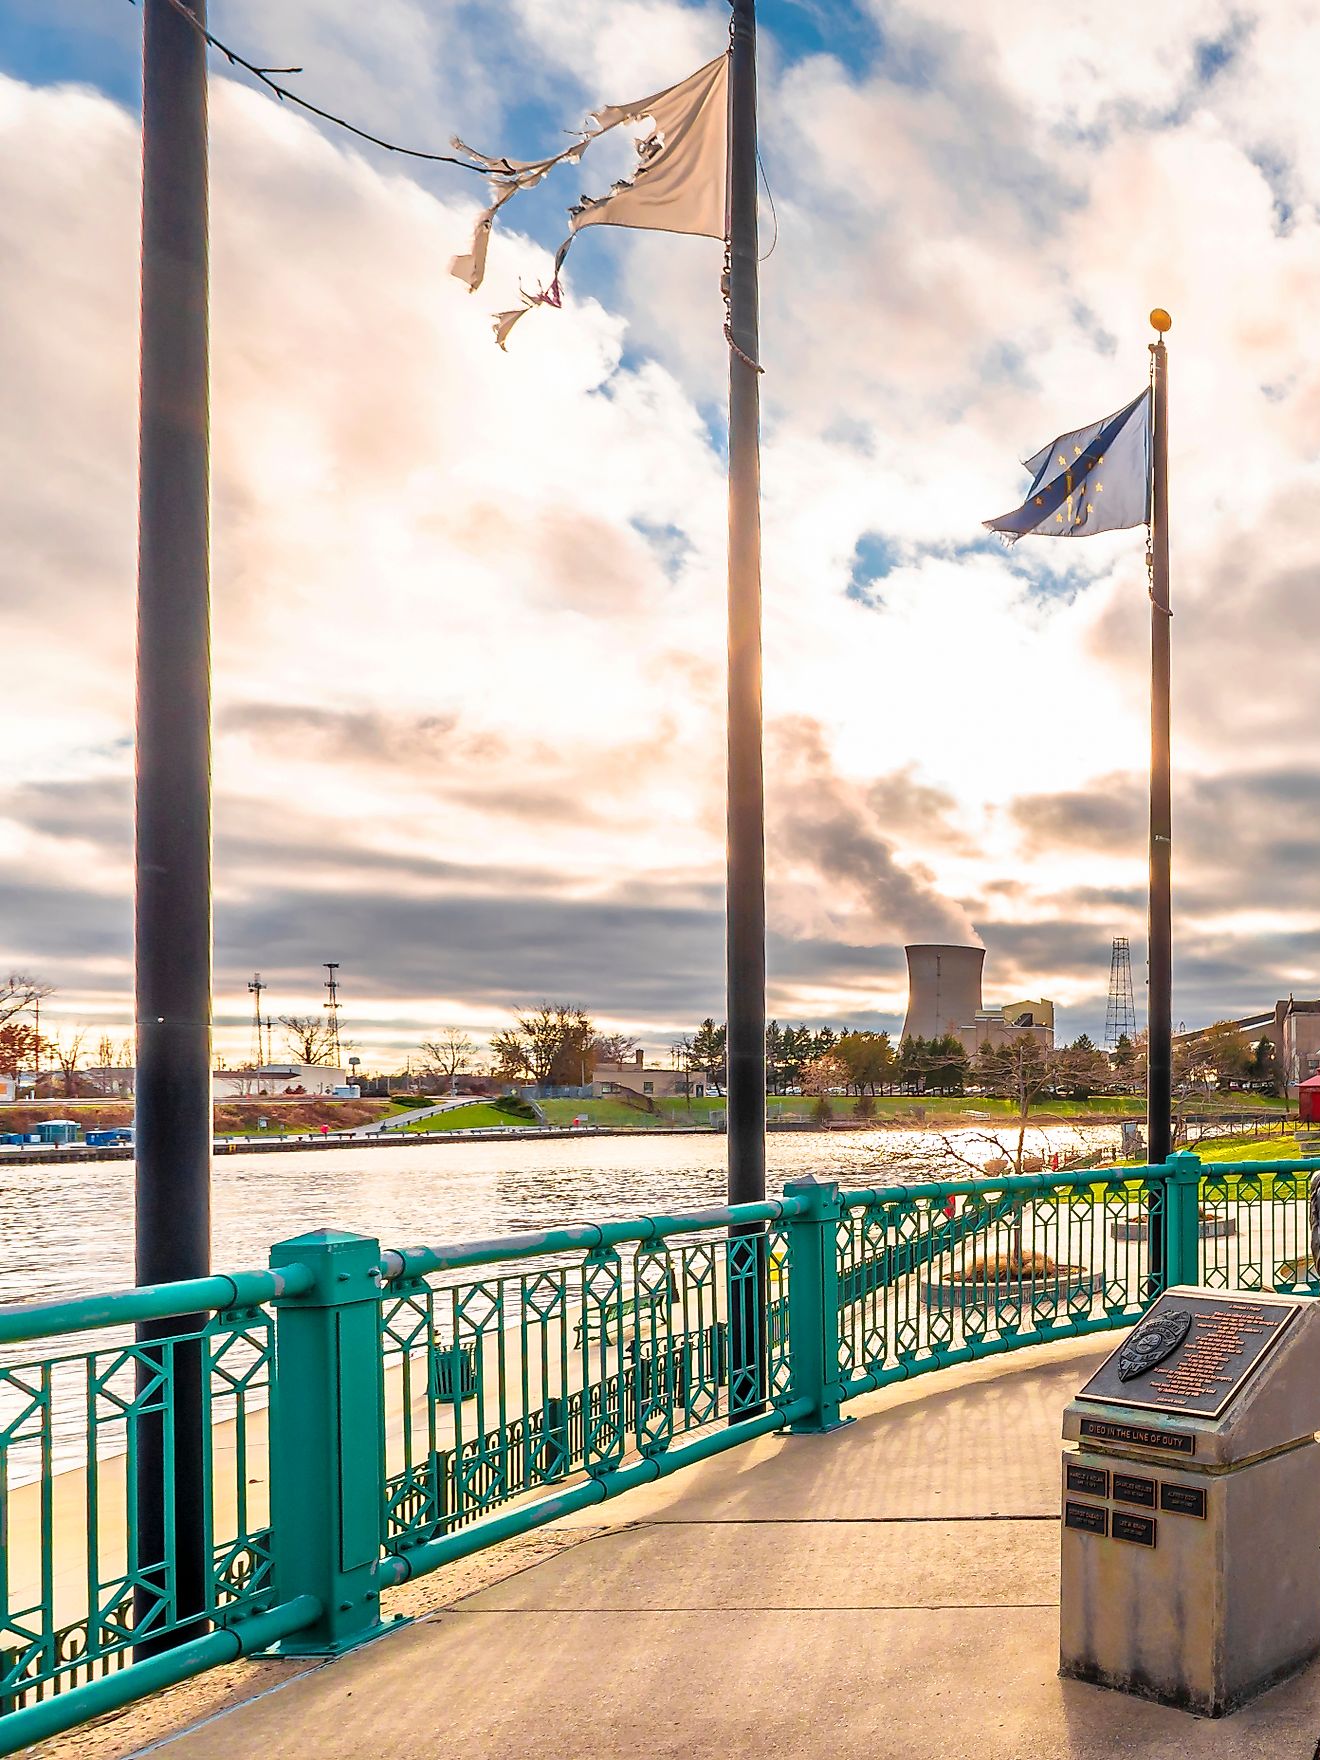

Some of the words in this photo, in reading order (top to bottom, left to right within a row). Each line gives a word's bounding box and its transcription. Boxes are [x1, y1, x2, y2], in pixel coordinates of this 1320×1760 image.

[1088, 1424, 1106, 1435] DIED
[1107, 1427, 1115, 1436] IN
[1116, 1429, 1131, 1439] THE
[1132, 1431, 1148, 1442] LINE
[1150, 1434, 1161, 1443] OF
[1162, 1436, 1183, 1447] DUTY
